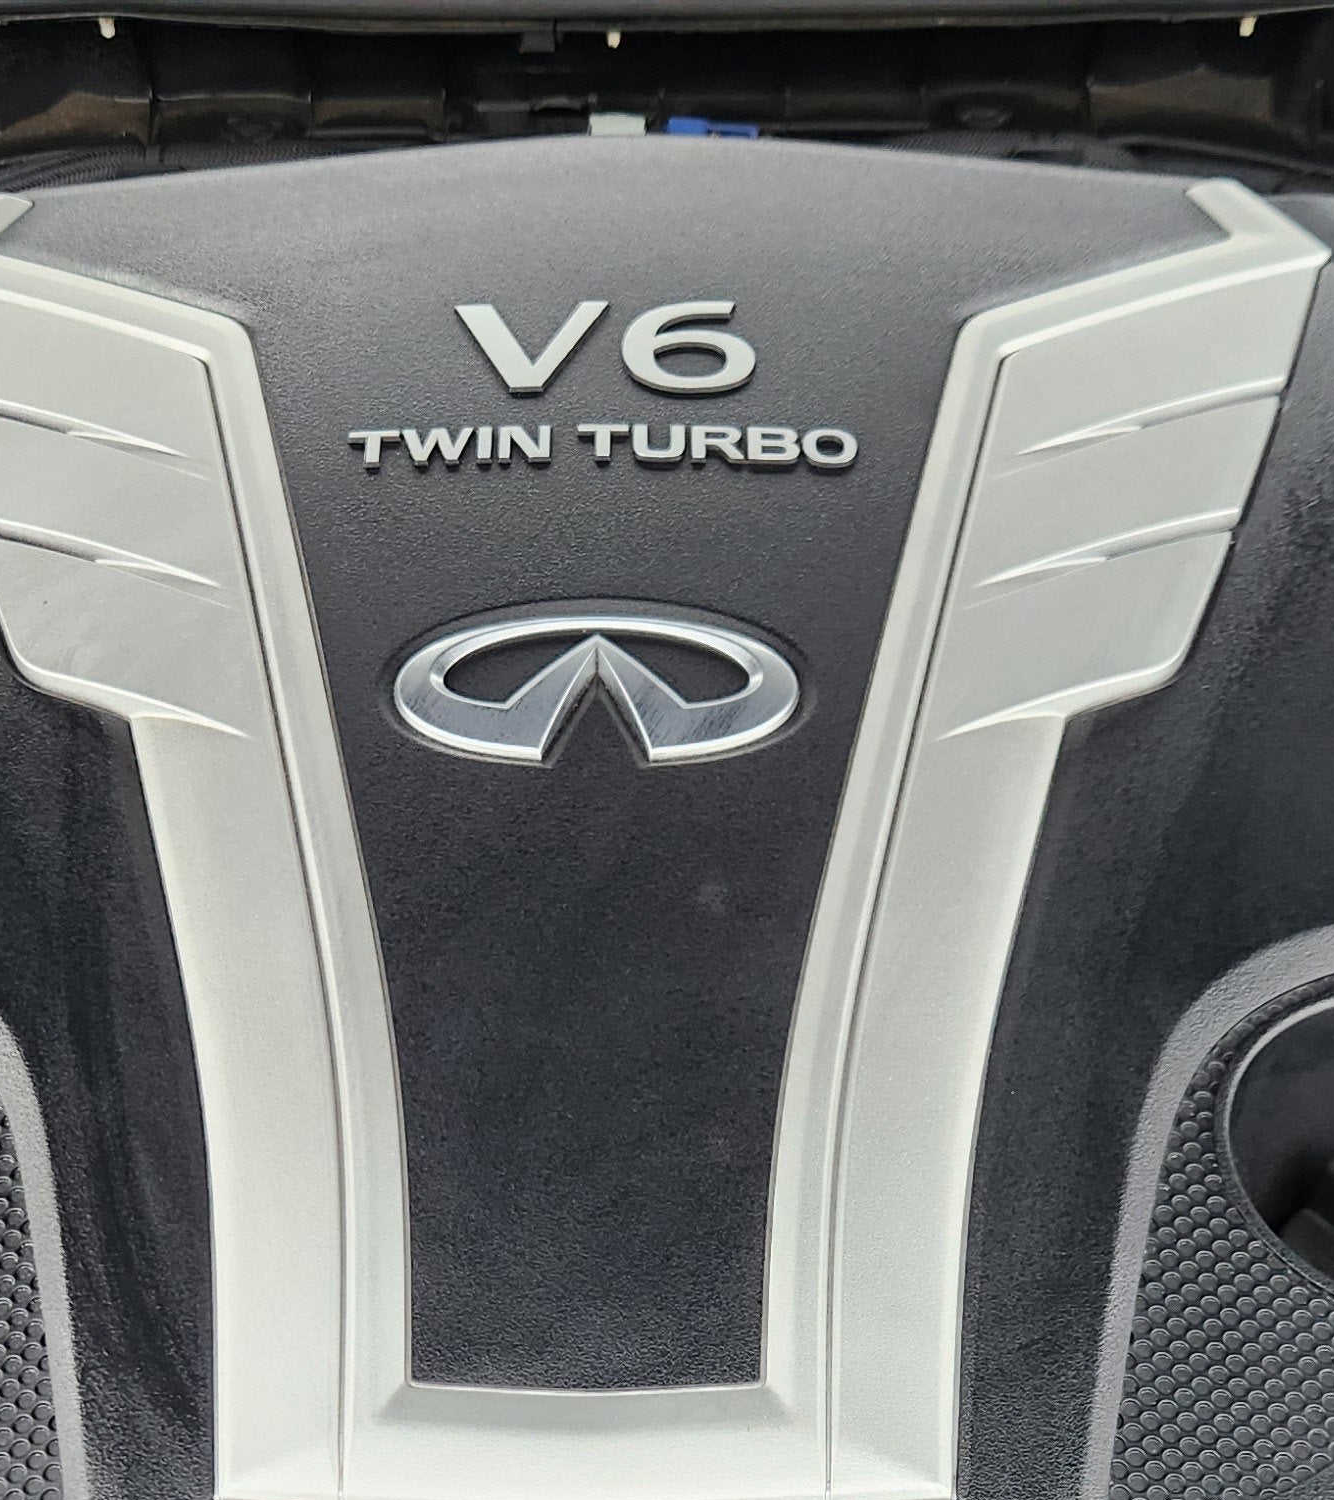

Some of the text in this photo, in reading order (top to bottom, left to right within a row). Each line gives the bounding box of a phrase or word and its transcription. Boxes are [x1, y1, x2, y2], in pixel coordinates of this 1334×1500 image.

[454, 300, 756, 394] V6
[348, 424, 859, 468] TWIN TURBO
